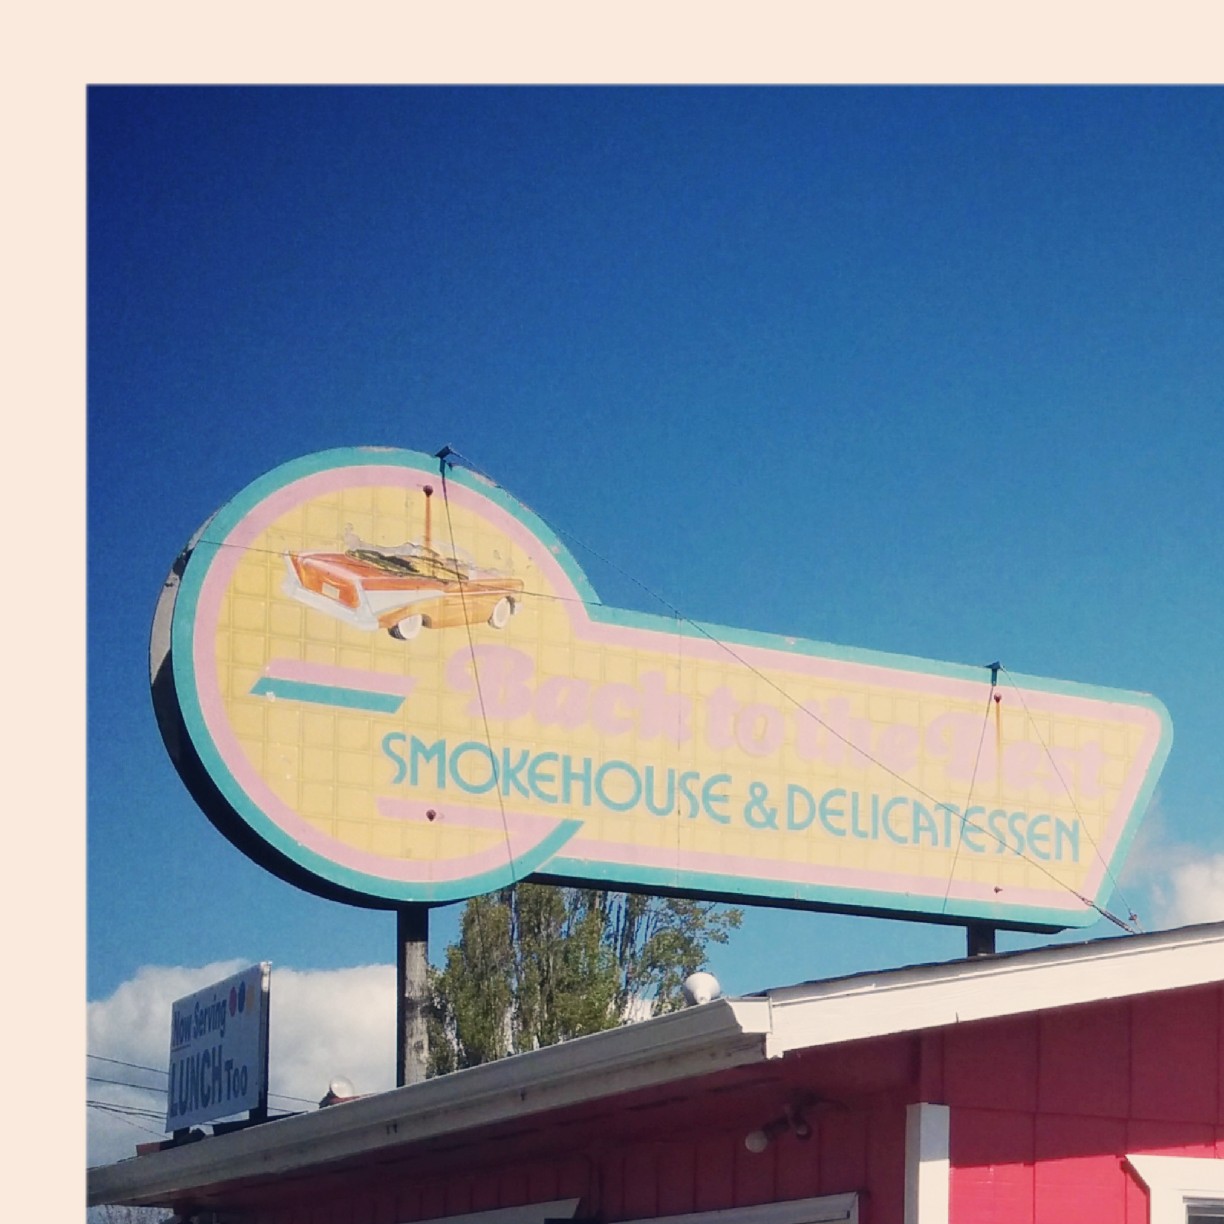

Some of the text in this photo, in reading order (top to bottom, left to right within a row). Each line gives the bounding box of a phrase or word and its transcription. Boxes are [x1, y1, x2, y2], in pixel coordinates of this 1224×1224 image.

[443, 644, 1110, 797] Back to the Best
[381, 731, 1080, 863] SMOKEHOUSE & DELICATESSEN
[172, 994, 228, 1048] Now Serving
[169, 1044, 223, 1118] LUNCH
